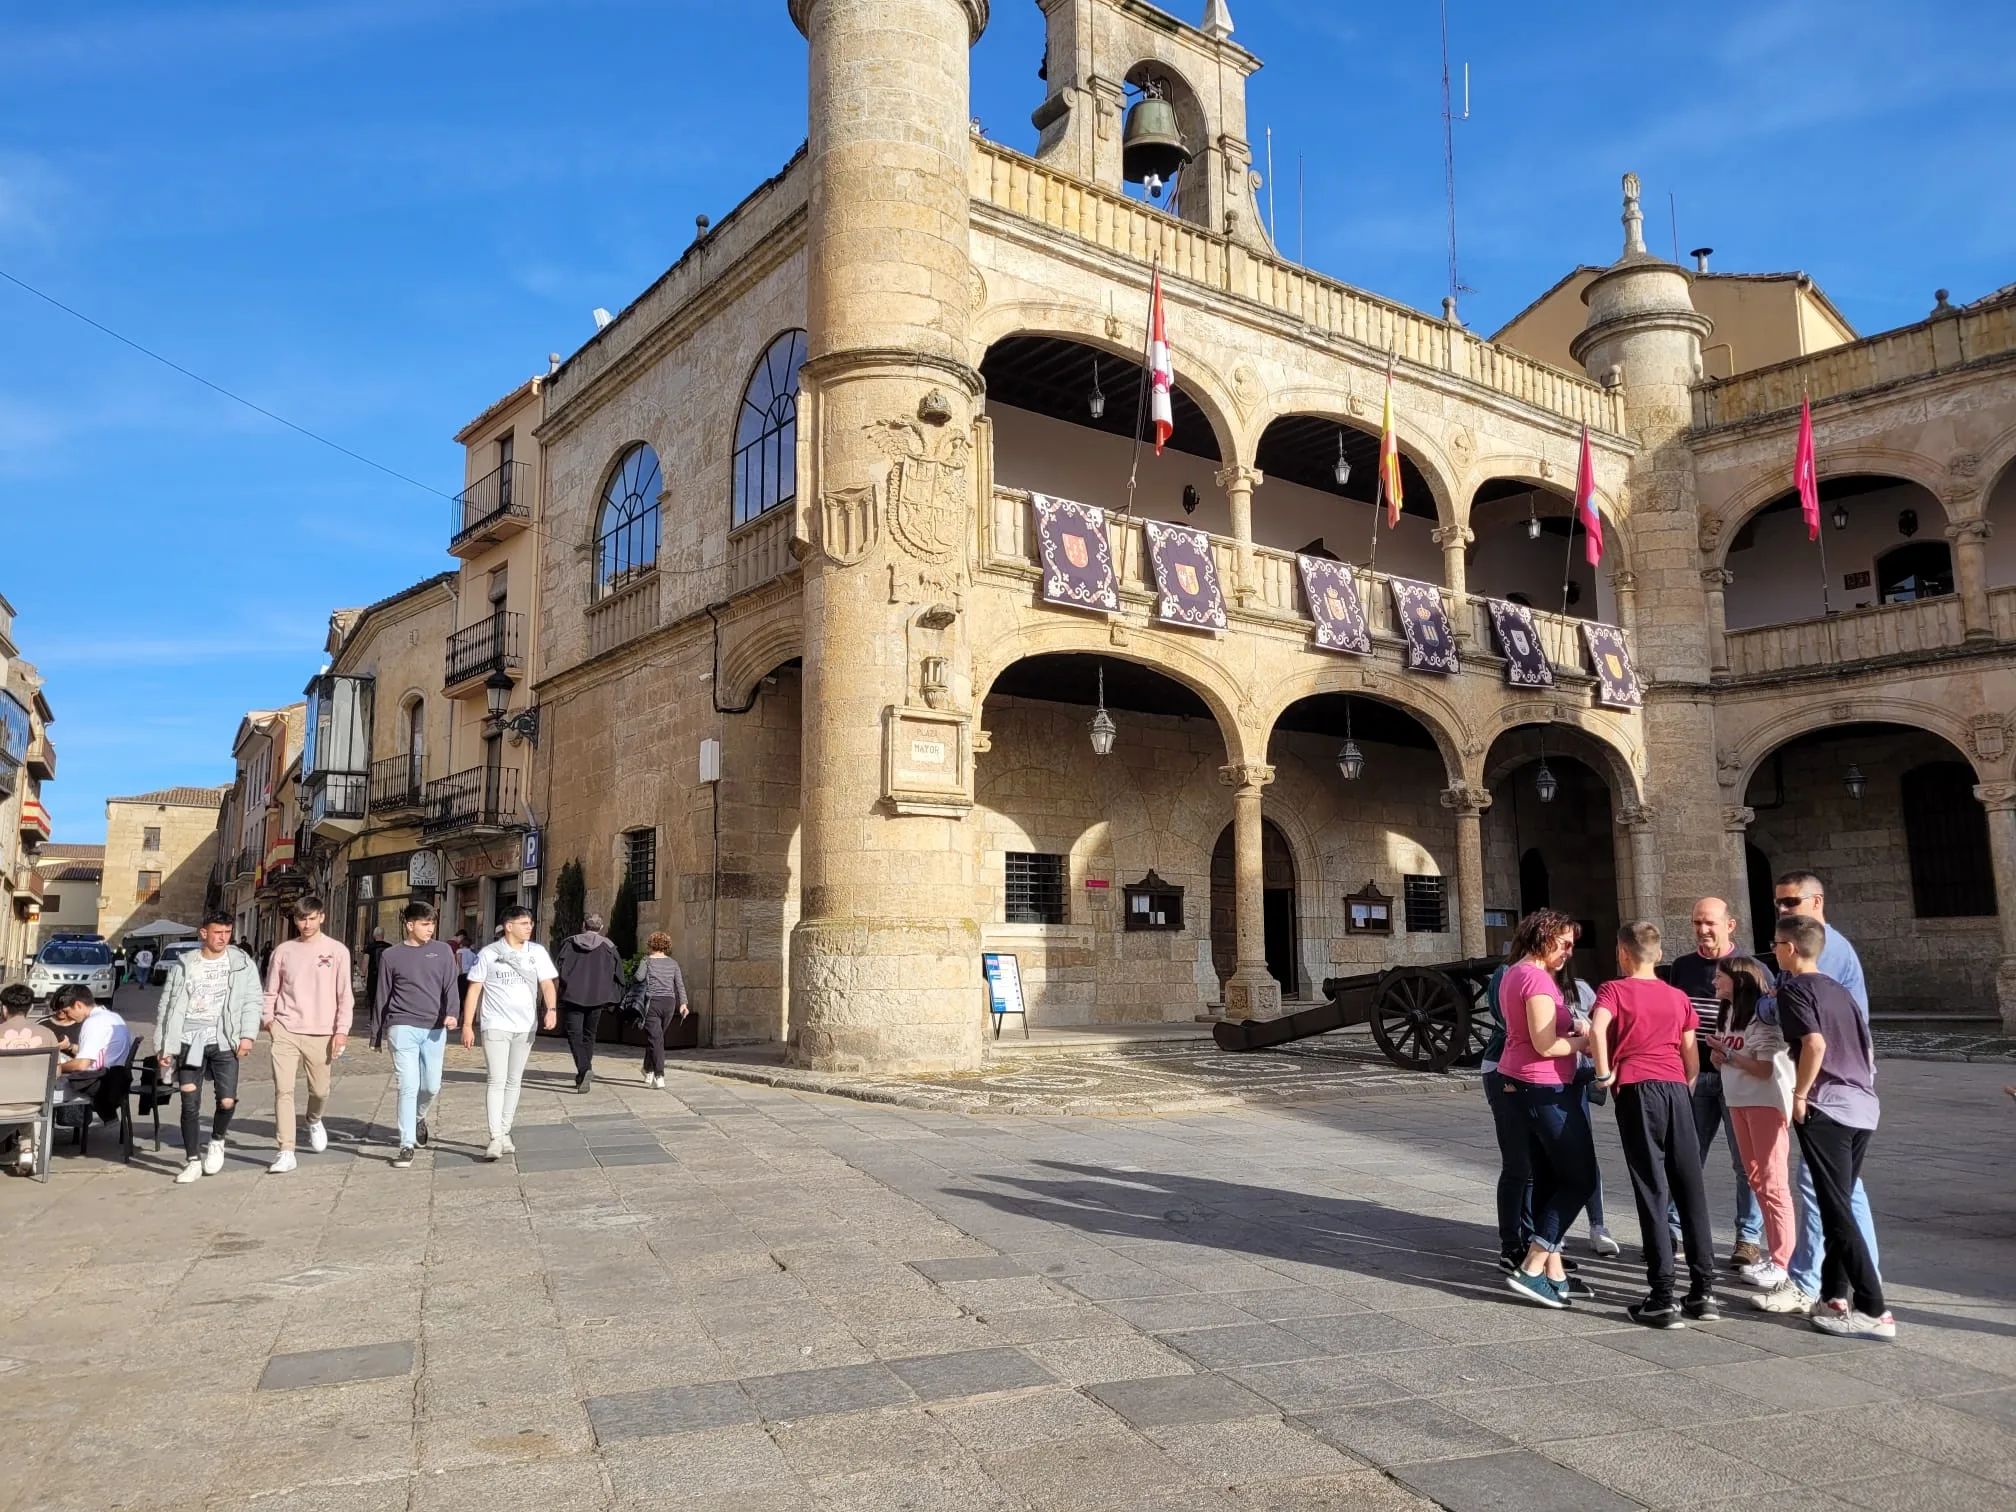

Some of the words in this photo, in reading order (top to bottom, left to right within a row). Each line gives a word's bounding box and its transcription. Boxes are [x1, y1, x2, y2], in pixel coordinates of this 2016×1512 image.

[916, 728, 938, 737] PLAZA
[914, 743, 940, 755] MAYOR
[527, 837, 535, 864] P
